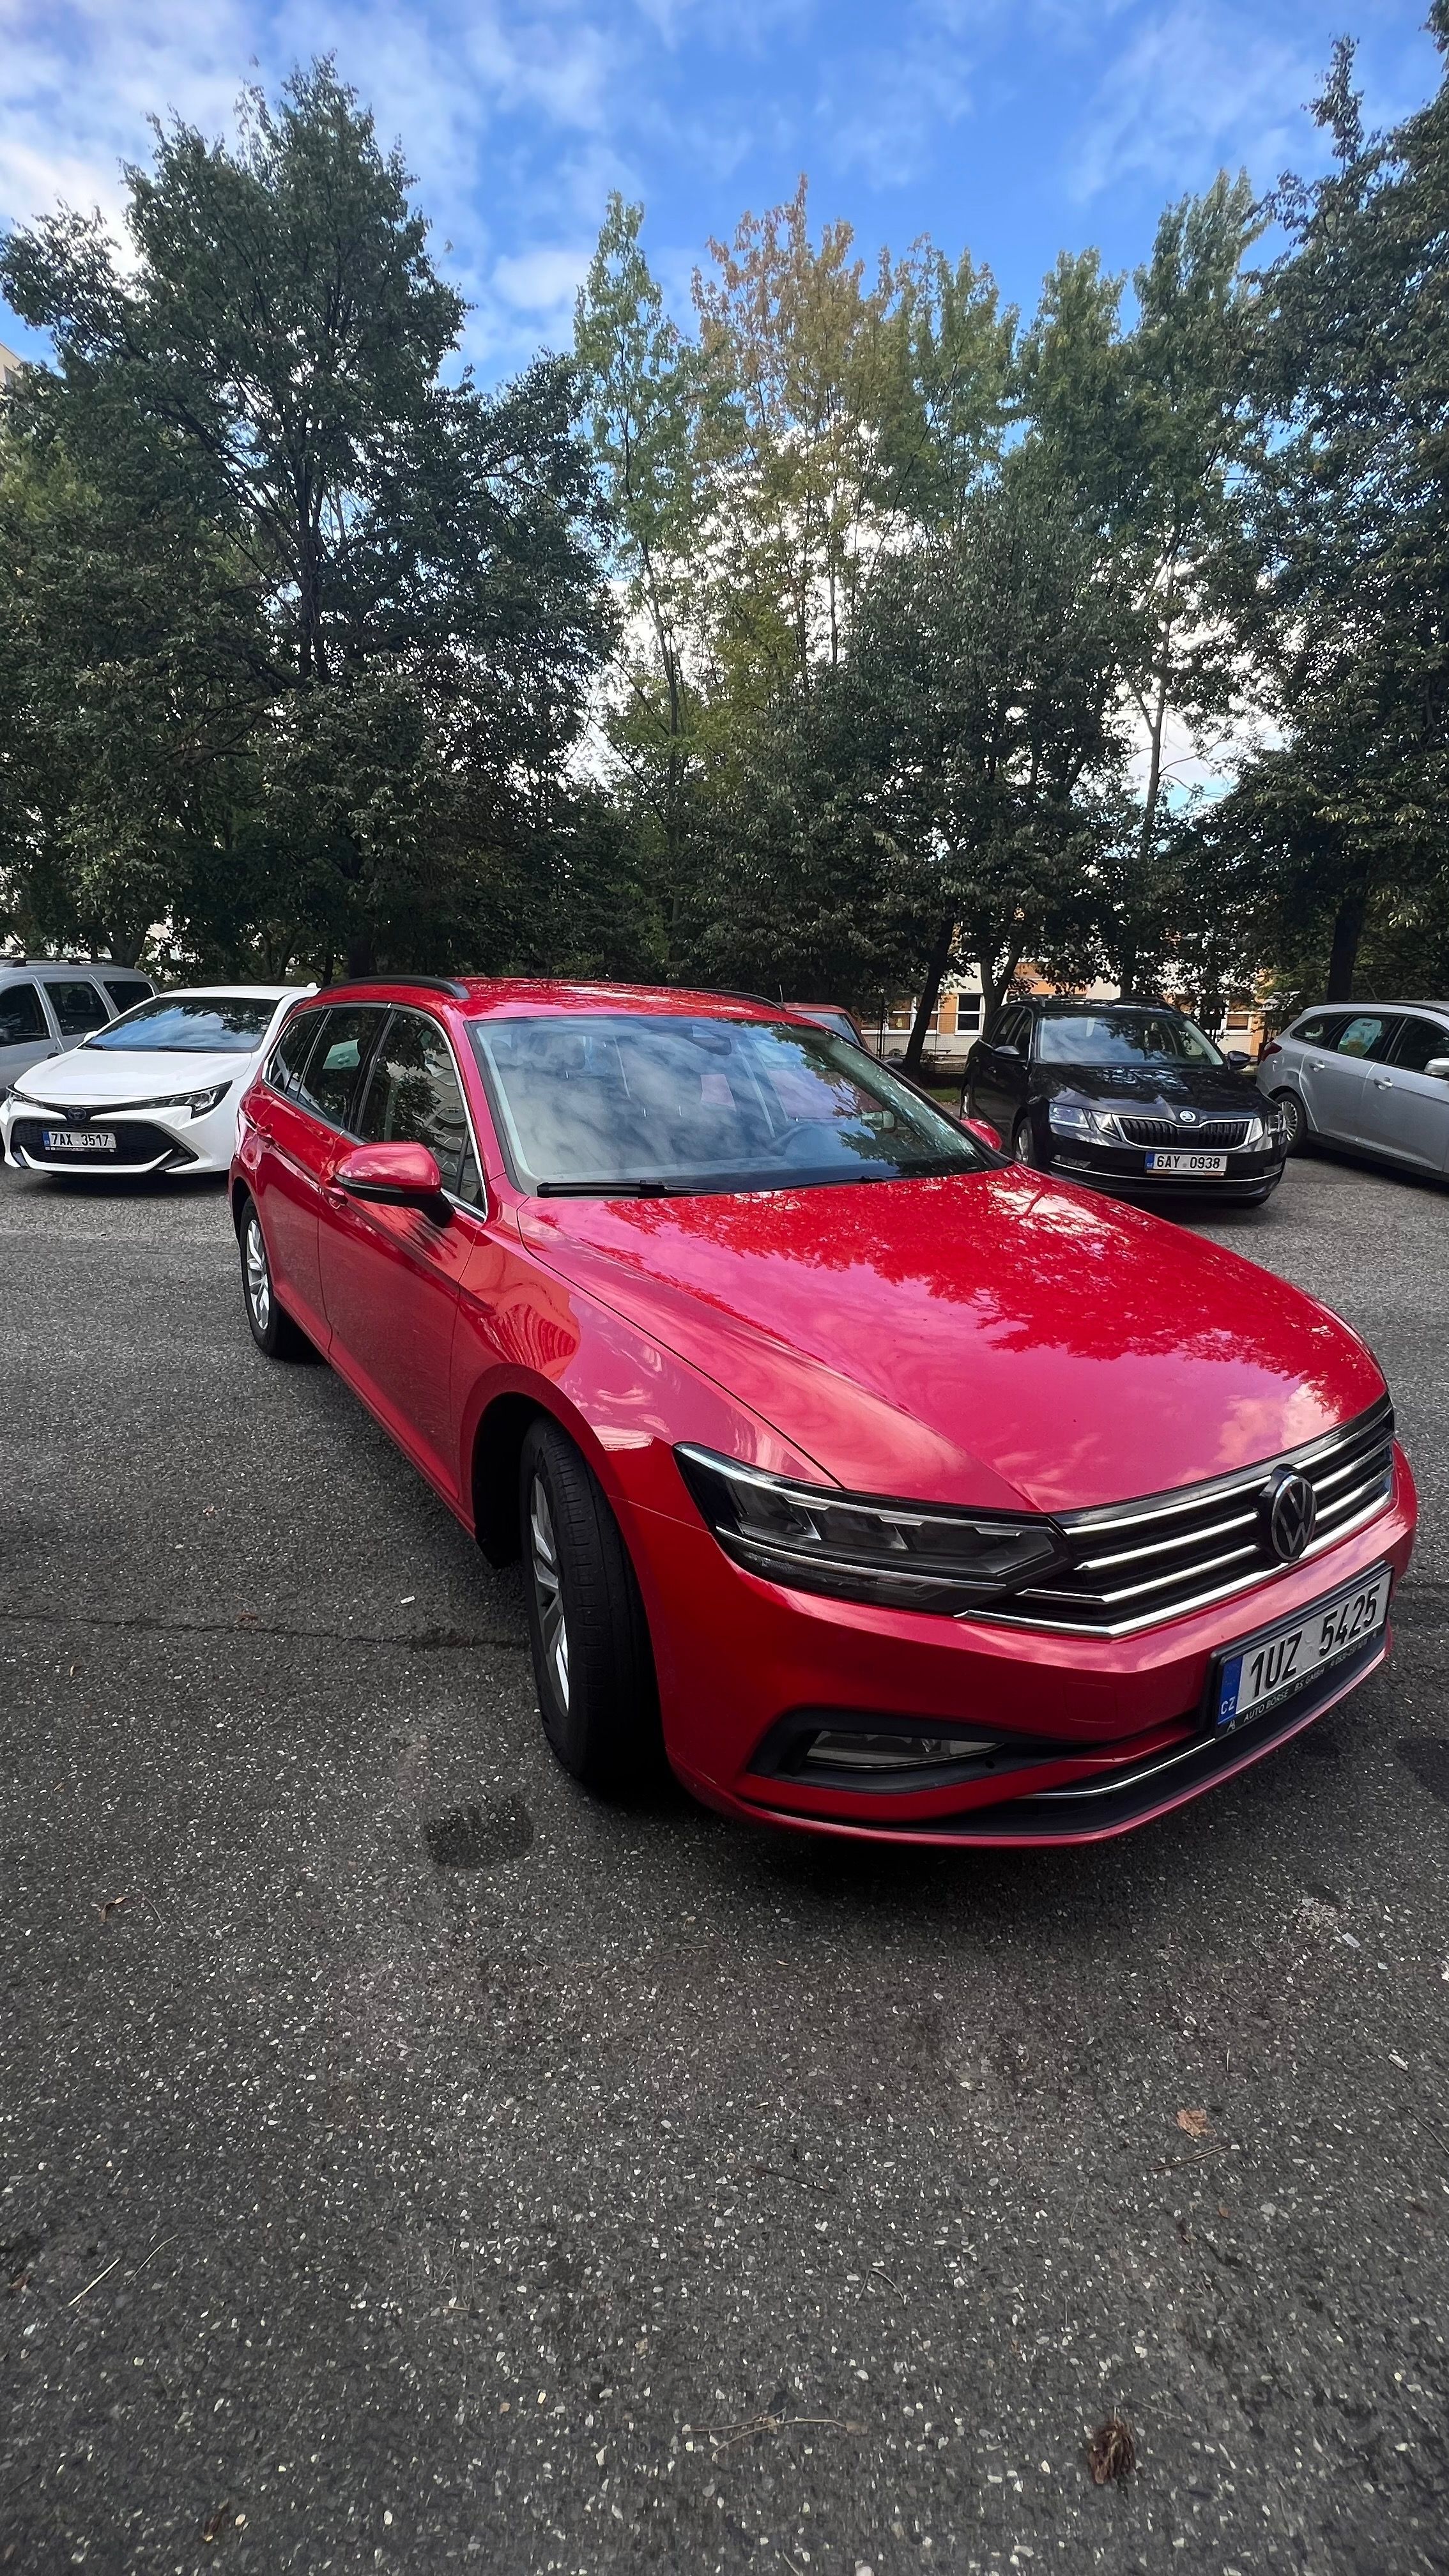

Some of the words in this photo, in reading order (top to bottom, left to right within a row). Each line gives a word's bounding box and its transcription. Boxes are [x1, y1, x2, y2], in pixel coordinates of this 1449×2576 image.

[50, 1133, 73, 1146] 7AX
[80, 1134, 109, 1147] 3517
[1156, 1155, 1181, 1169] 6AY
[1190, 1156, 1221, 1169] 0938
[1250, 1630, 1303, 1698] 1UZ
[1319, 1581, 1381, 1657] 5425
[1220, 1696, 1236, 1715] CZ
[1243, 1704, 1265, 1723] AUTO
